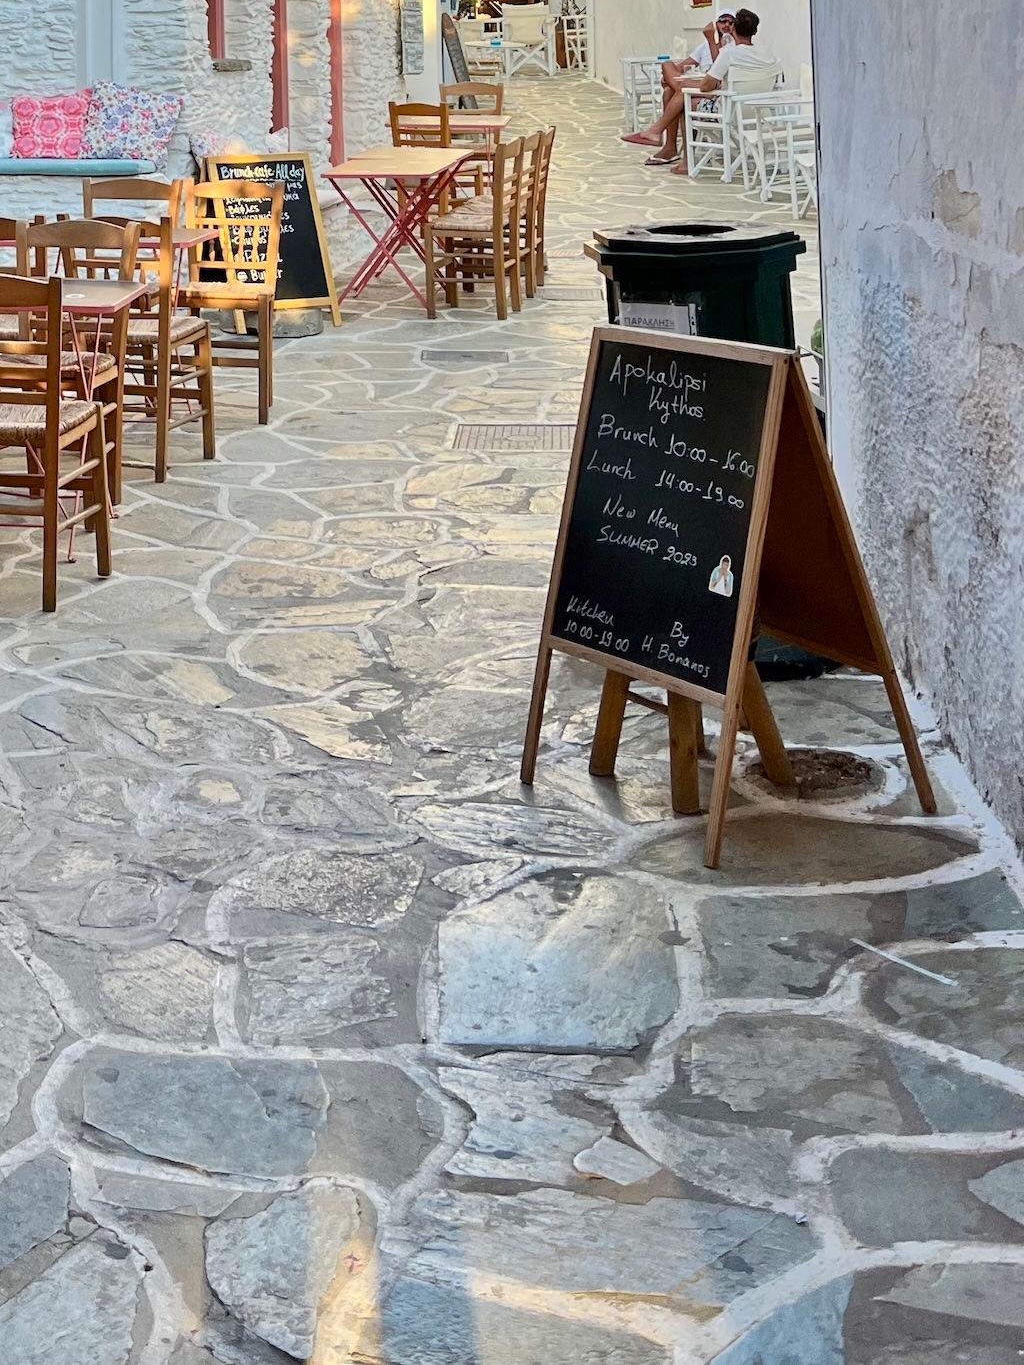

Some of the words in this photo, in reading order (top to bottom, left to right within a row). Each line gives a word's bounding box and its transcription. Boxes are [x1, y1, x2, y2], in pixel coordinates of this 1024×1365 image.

[609, 354, 707, 402] Apokalipsi
[597, 413, 658, 448] Brunch
[586, 449, 637, 480] Lunch
[602, 494, 636, 519] New
[647, 507, 679, 537] Menu
[596, 525, 659, 555] SUMMER
[662, 546, 697, 567] 2023
[566, 595, 615, 627] Kitchen
[669, 621, 689, 648] By
[657, 643, 710, 678] Bonanos
